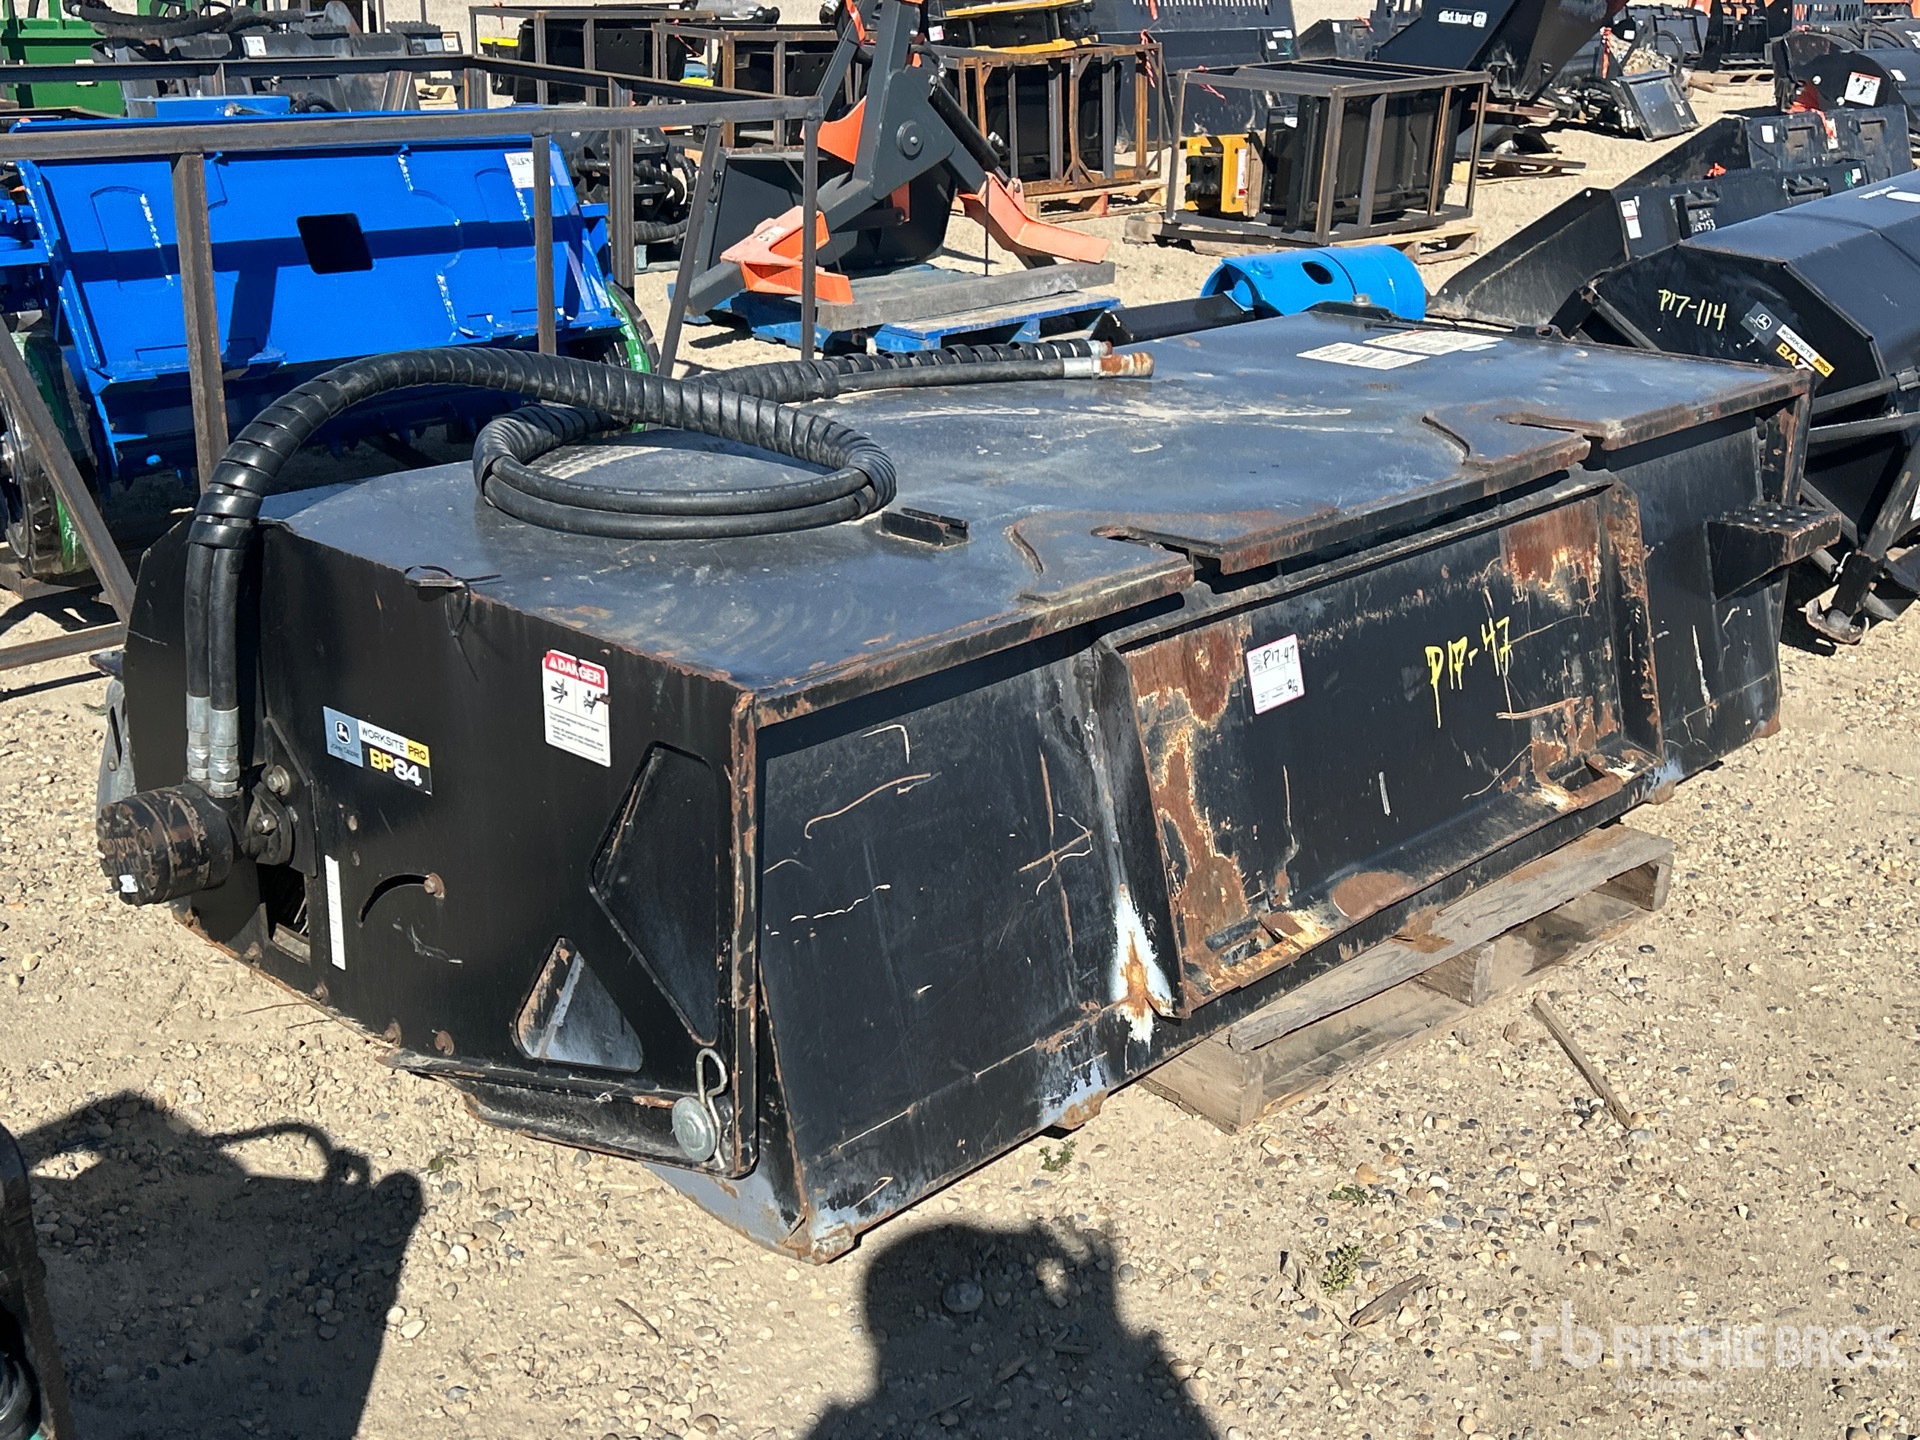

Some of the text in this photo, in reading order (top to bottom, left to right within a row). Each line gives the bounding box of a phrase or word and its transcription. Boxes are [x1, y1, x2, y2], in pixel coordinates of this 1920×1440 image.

[1658, 289, 1727, 331] P17-114
[1781, 329, 1830, 373] WORKSITE PRO
[1425, 616, 1512, 700] P17-47
[361, 727, 427, 761] WORKSITE PRO
[369, 747, 423, 787] BP84
